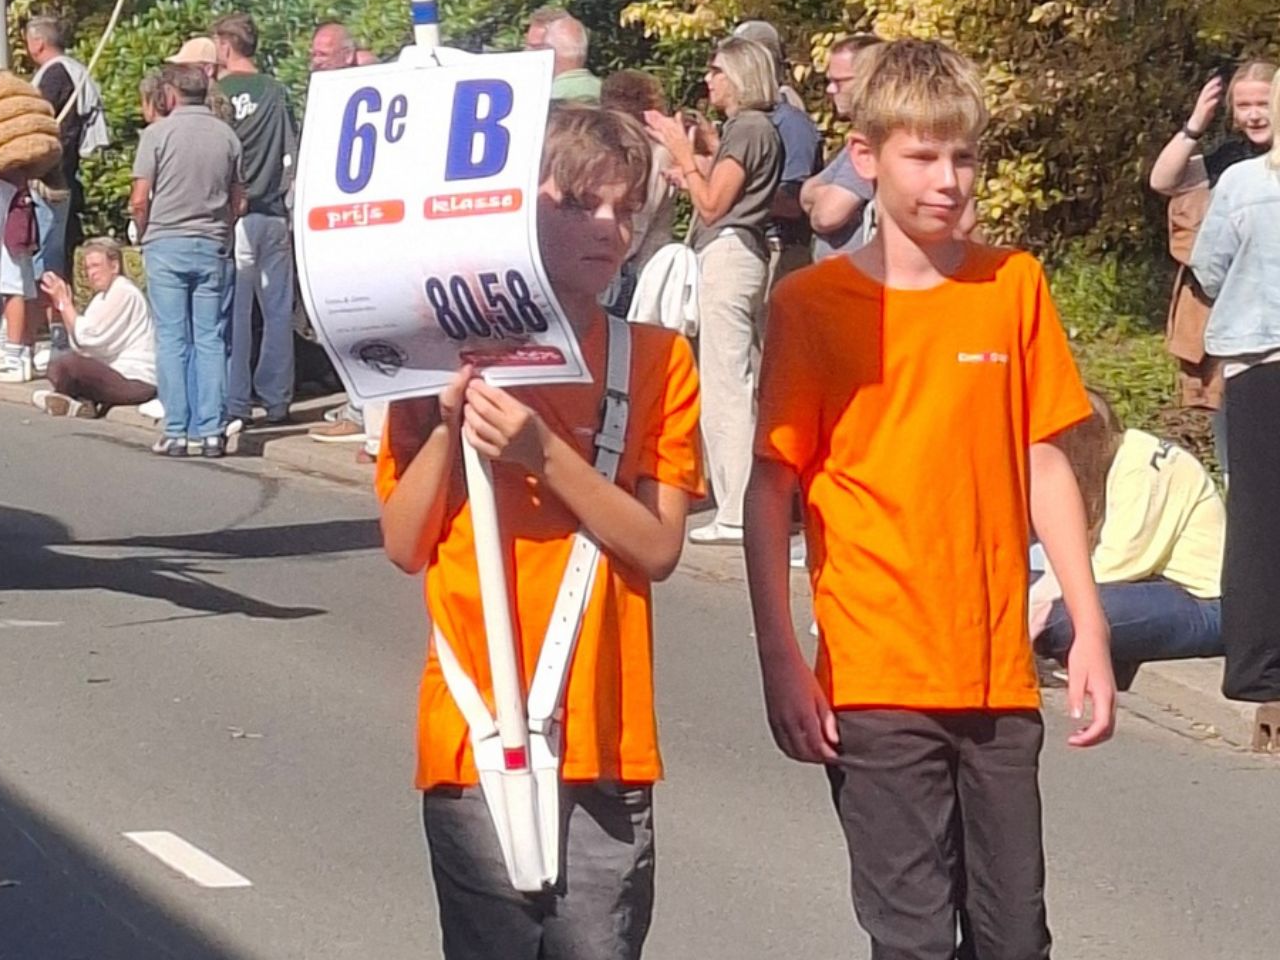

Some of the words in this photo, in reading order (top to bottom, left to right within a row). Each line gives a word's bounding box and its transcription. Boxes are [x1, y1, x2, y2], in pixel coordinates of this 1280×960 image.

[335, 86, 409, 195] 6e
[445, 78, 515, 182] B
[326, 202, 384, 229] prijs
[431, 193, 514, 214] klasse
[424, 269, 549, 341] 80,58
